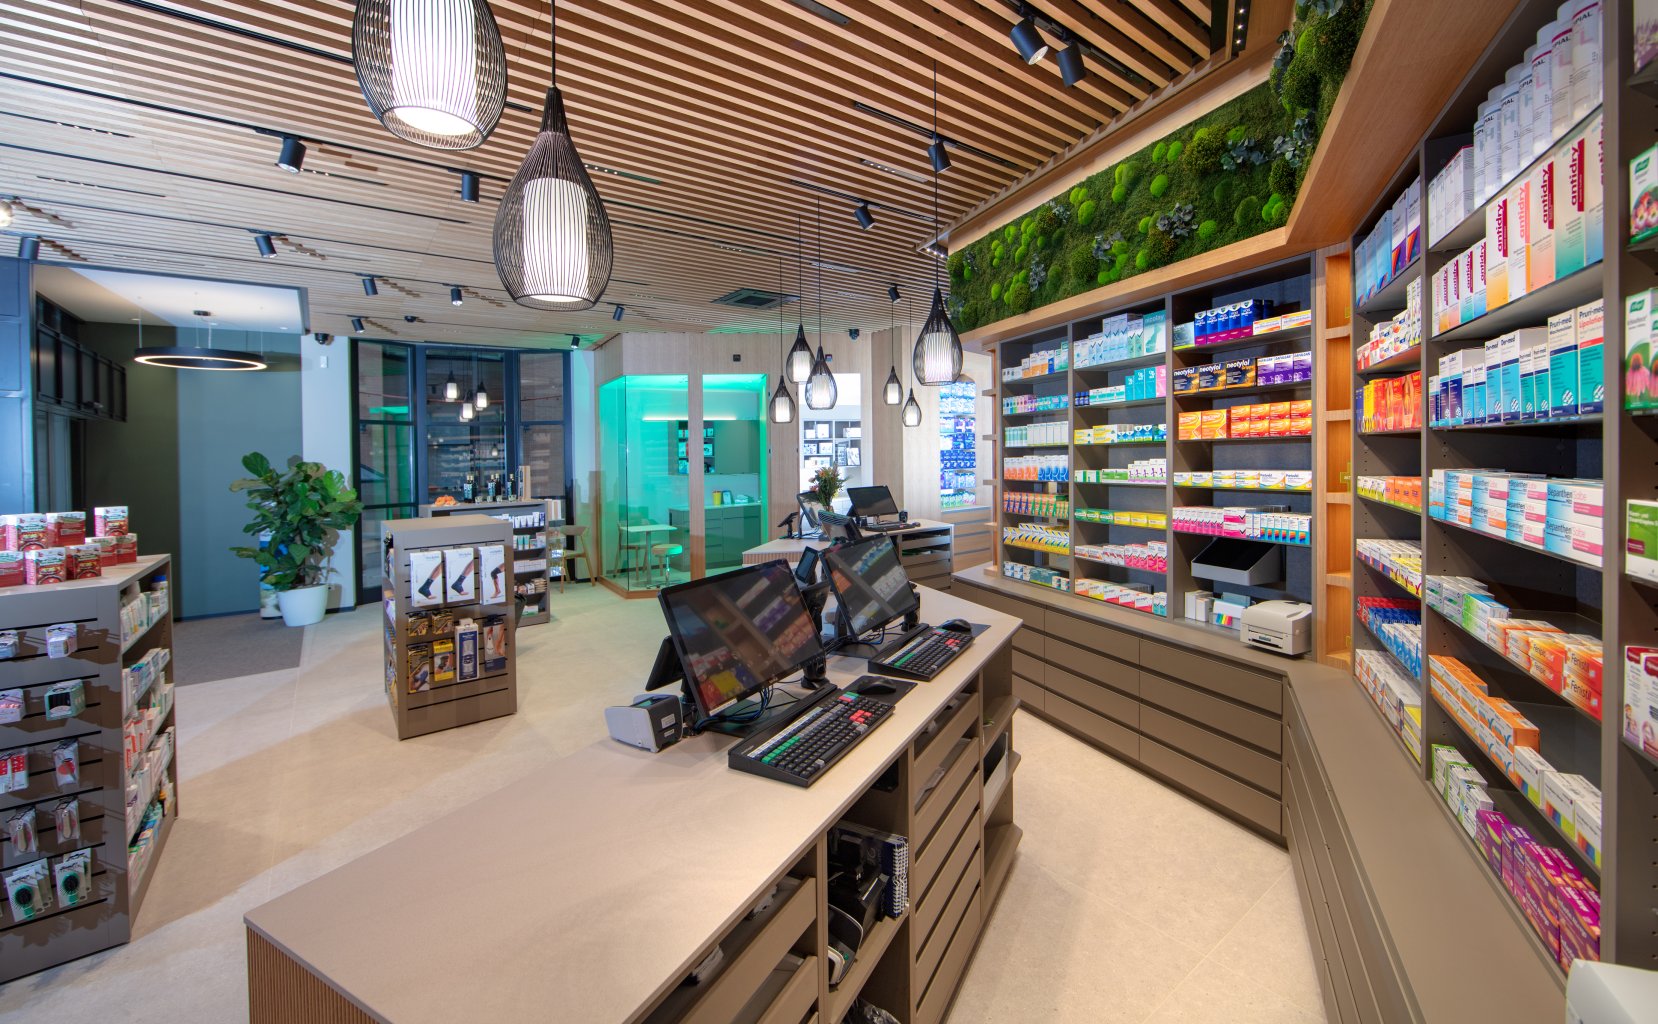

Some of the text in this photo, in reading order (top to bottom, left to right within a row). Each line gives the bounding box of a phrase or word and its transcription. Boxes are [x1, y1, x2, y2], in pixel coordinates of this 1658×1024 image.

[1569, 146, 1579, 206] antidry
[1518, 186, 1526, 238] antidry
[1541, 168, 1549, 224] antidry
[1496, 204, 1504, 252] antidry
[1548, 488, 1572, 501] Bepanthen
[1547, 522, 1572, 536] Bepanthen
[1572, 652, 1590, 673] Fenistil
[1570, 680, 1592, 700] Fenistil
